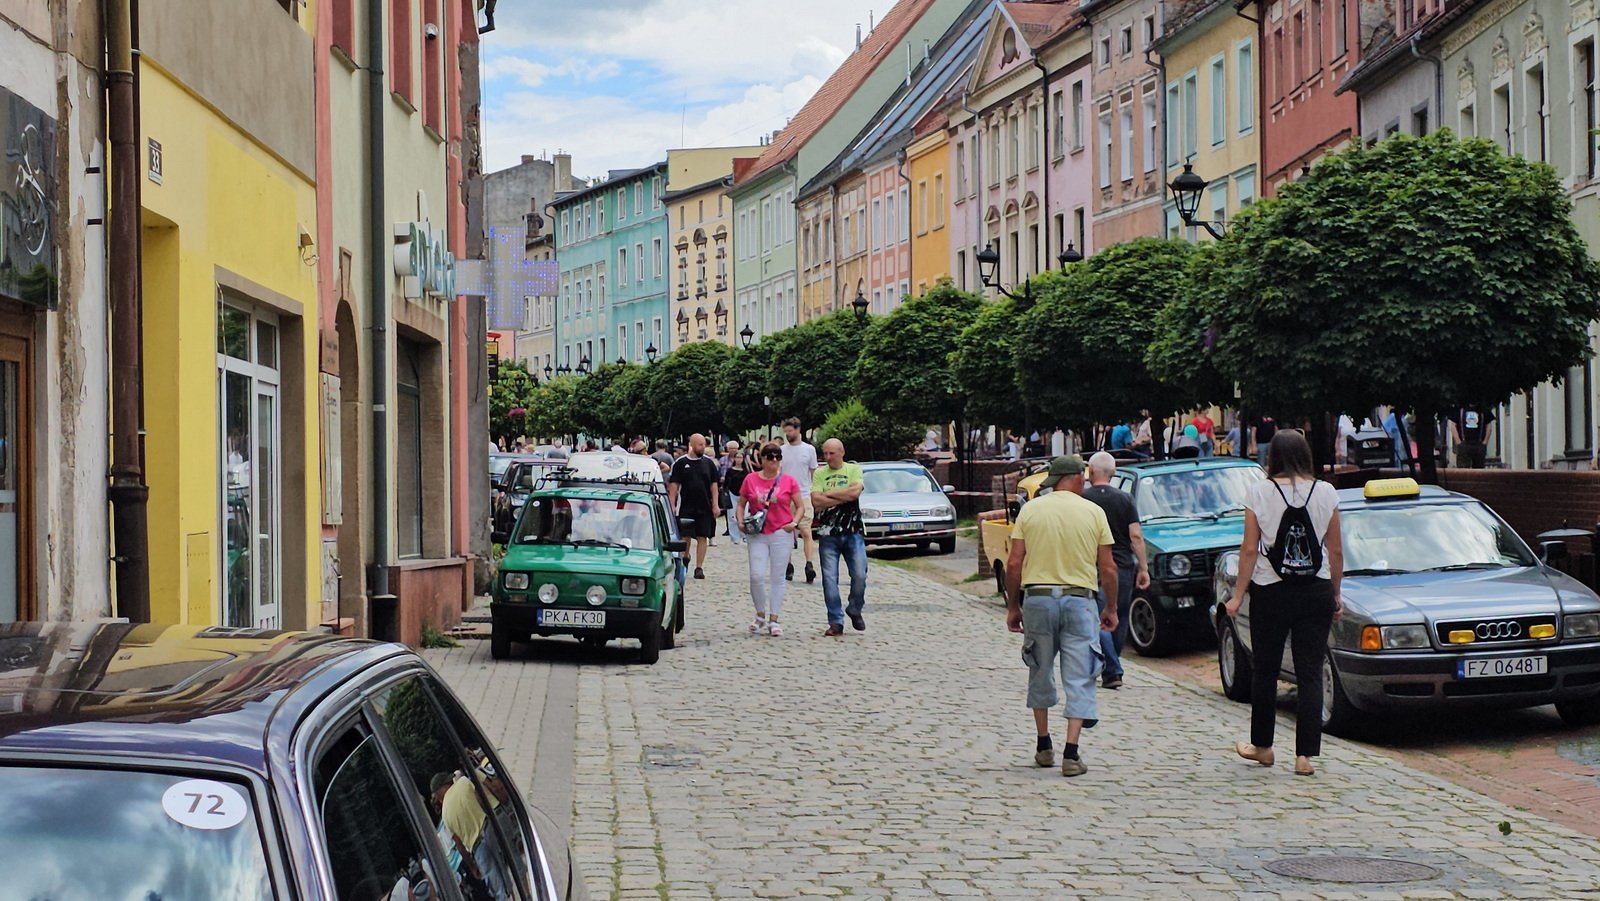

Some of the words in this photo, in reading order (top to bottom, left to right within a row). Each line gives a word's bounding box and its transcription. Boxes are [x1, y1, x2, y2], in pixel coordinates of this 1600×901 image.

[151, 149, 160, 173] 33
[544, 610, 570, 623] PKA
[573, 611, 603, 624] FK30
[1468, 658, 1489, 676] FZ
[1494, 656, 1544, 674] 0648T
[183, 792, 226, 816] 72
